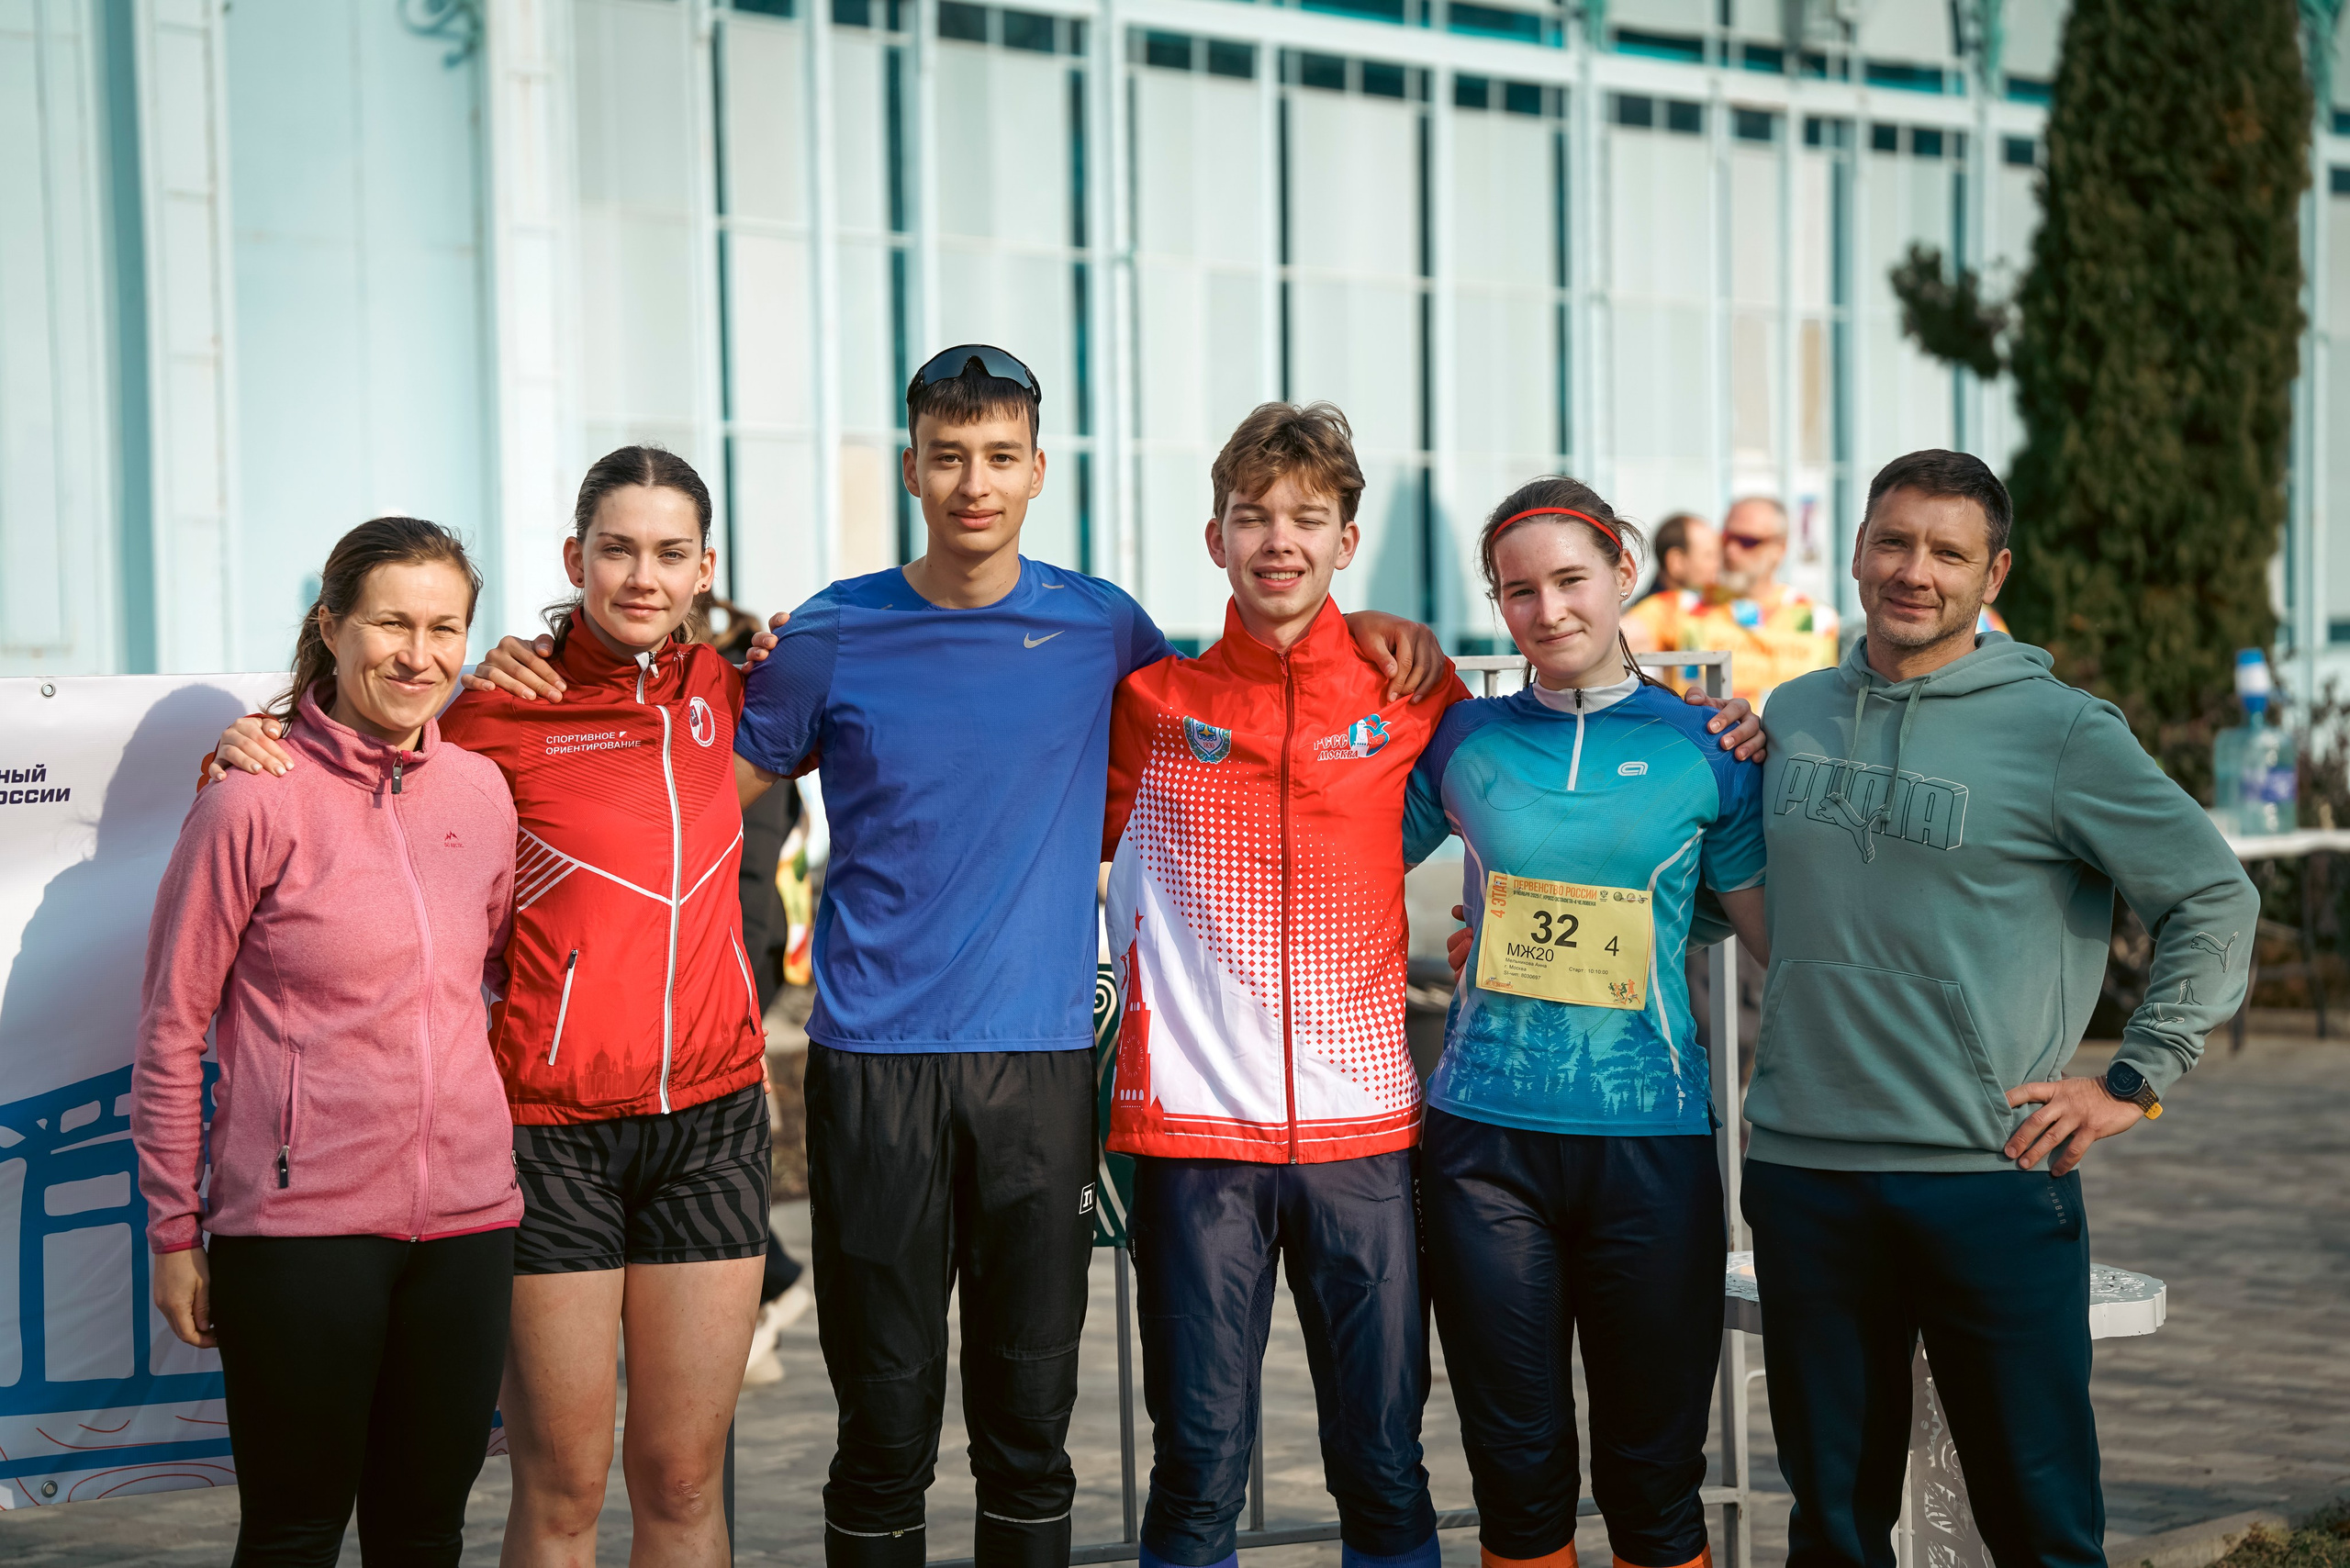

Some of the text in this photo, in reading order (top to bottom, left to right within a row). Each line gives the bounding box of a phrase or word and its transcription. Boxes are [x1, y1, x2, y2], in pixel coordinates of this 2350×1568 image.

[545, 732, 616, 745] СПОРТИВНОЕ
[545, 740, 642, 756] ОРИЕНТИРОВАНИЕ
[1203, 741, 1215, 749] 1830
[1317, 749, 1359, 761] МОСКВА
[1774, 752, 1969, 851] PUMA
[1491, 875, 1508, 919] 4 ЭТАП
[1513, 879, 1597, 901] ПЕРВЕНСТВО РОССИИ
[1530, 910, 1580, 948] 32
[1506, 942, 1554, 962] МЖ20
[1605, 935, 1619, 957] 4
